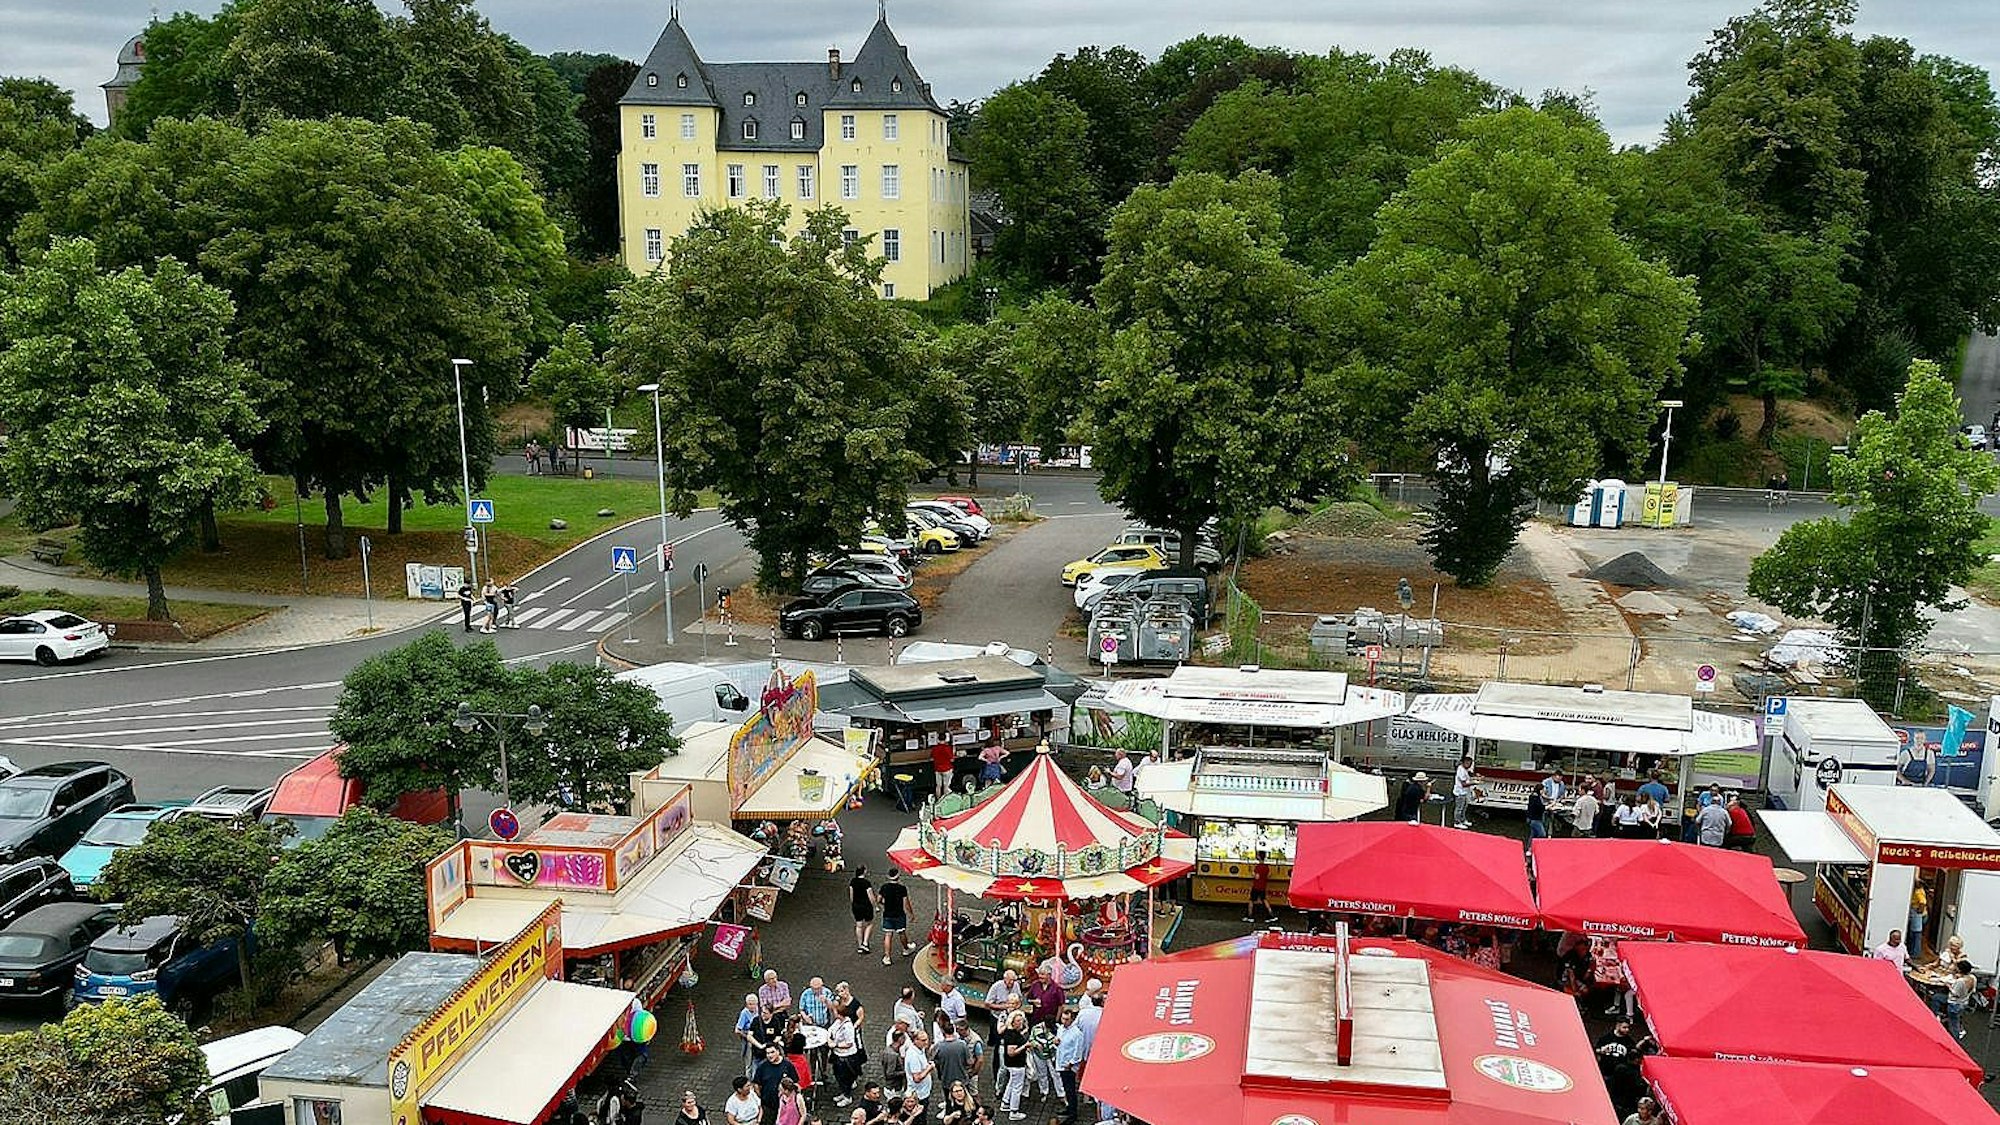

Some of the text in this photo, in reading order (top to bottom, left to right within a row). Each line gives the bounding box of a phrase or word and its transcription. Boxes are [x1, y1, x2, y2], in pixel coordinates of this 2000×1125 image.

[1770, 699, 1783, 713] P
[1391, 728, 1414, 740] GLAS
[421, 939, 542, 1071] PFEILWERFEN
